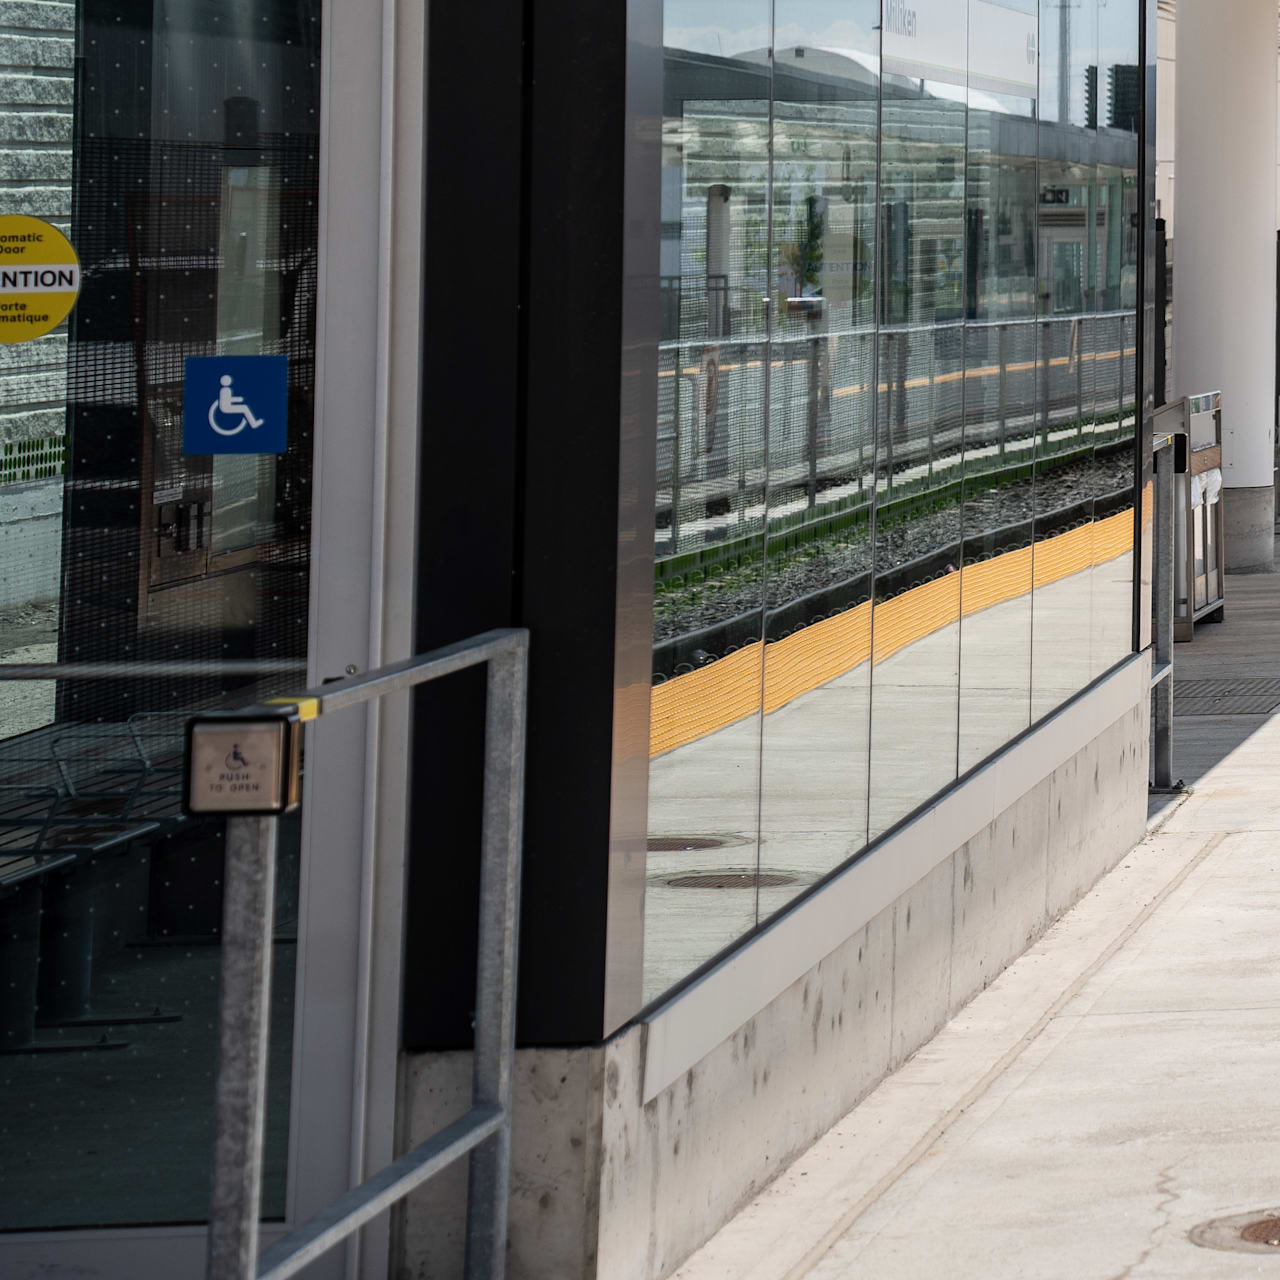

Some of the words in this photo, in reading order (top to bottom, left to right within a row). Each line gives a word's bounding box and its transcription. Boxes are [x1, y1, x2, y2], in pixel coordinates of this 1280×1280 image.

[2, 270, 73, 287] NTION
[219, 773, 249, 781] PUSH
[210, 783, 223, 793] TO
[230, 783, 260, 792] OPEN
